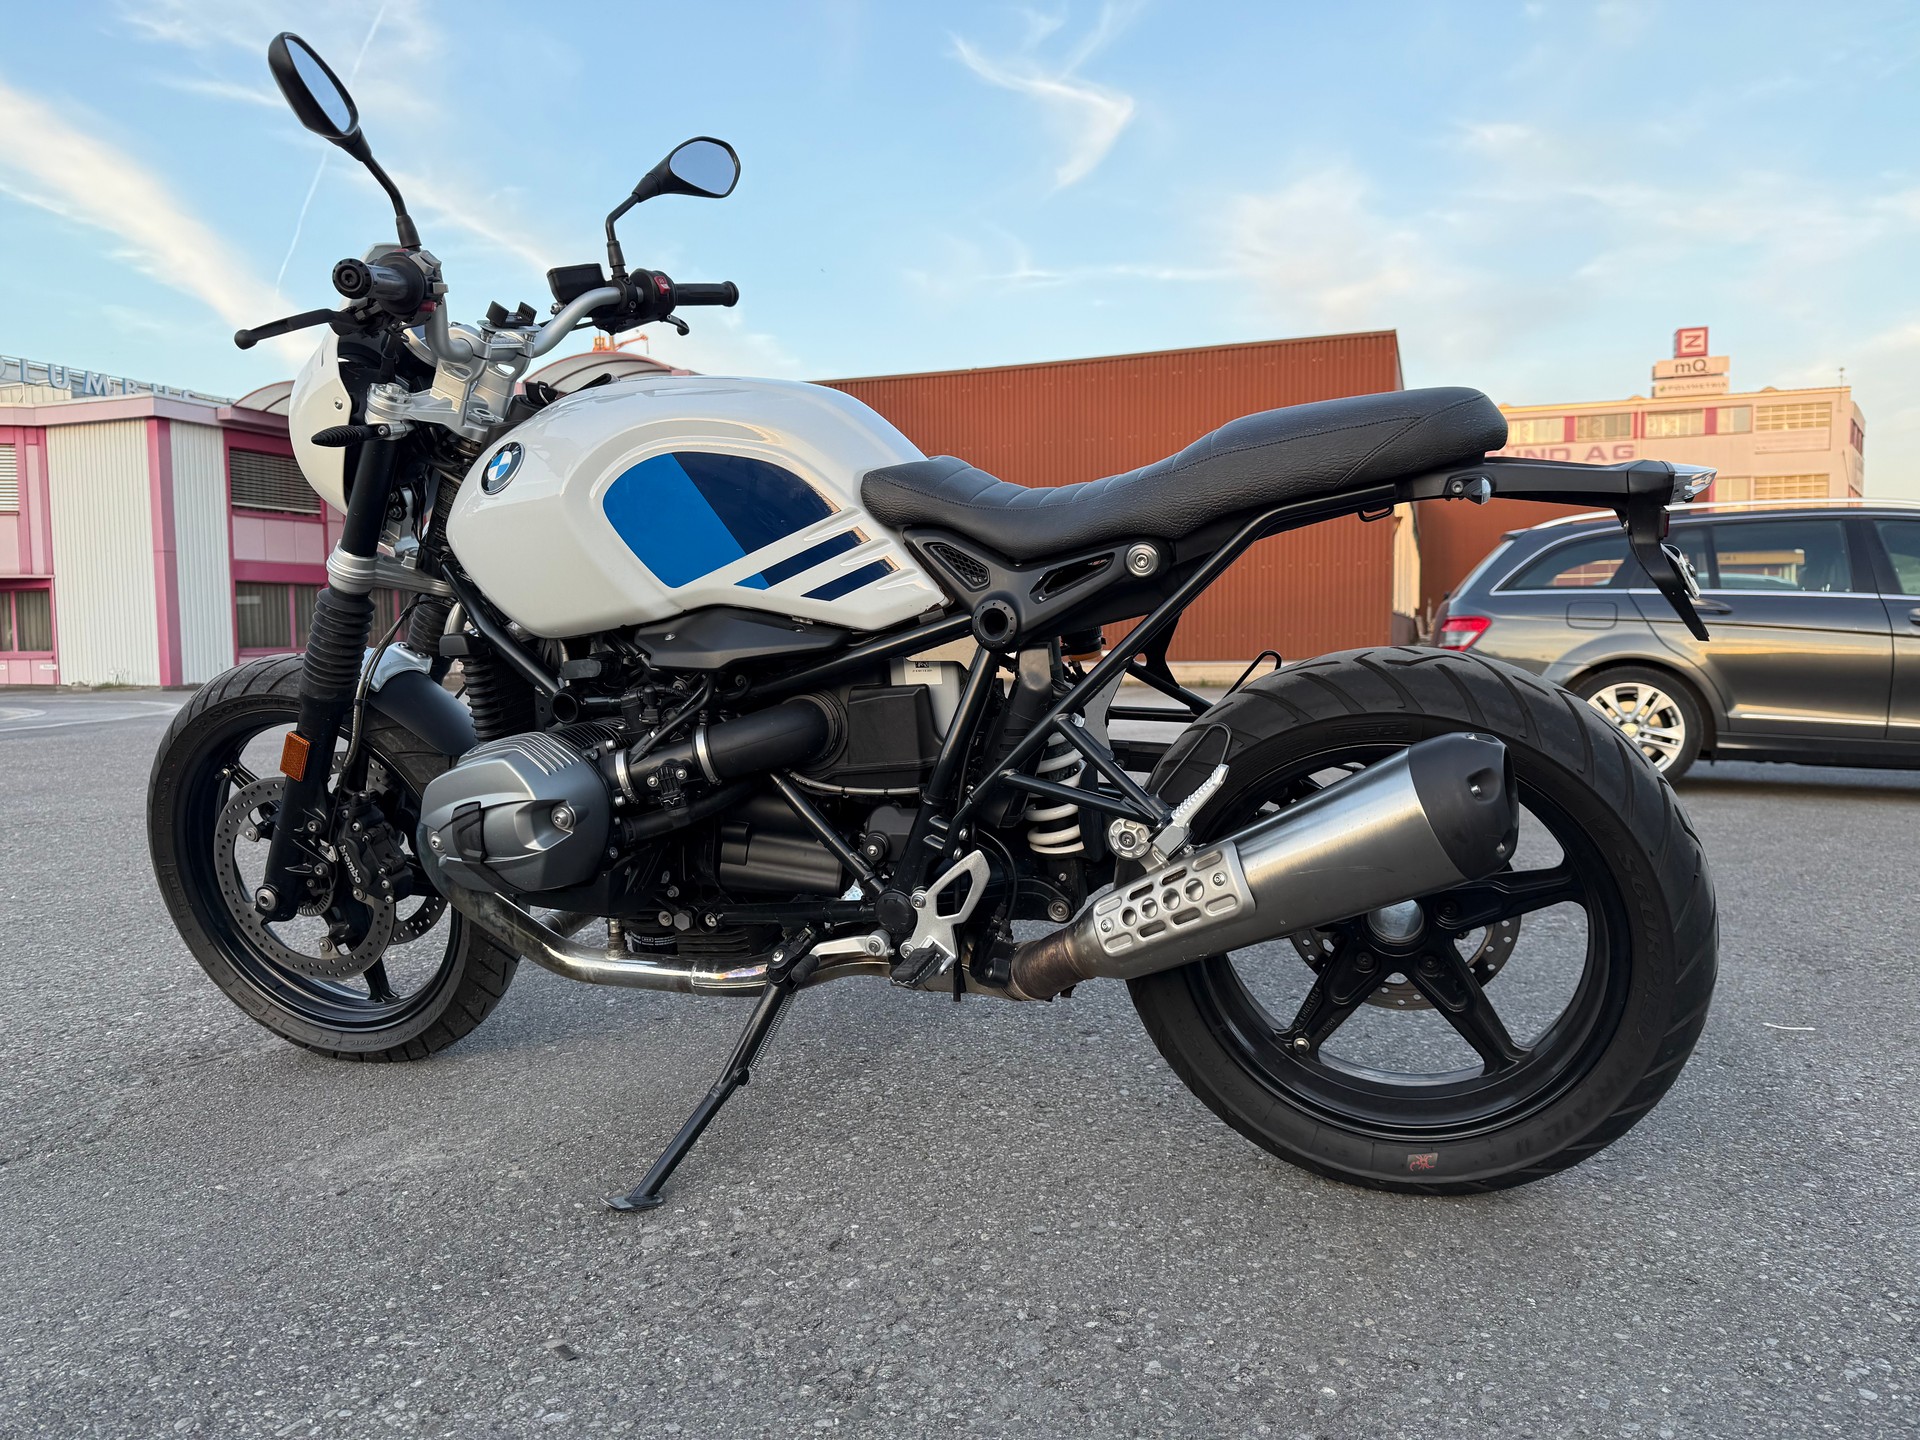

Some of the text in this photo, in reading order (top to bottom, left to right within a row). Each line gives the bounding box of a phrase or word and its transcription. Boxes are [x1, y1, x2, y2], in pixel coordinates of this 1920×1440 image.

[1675, 358, 1710, 374] mQ
[1584, 444, 1636, 461] AG
[338, 844, 362, 884] brembo
